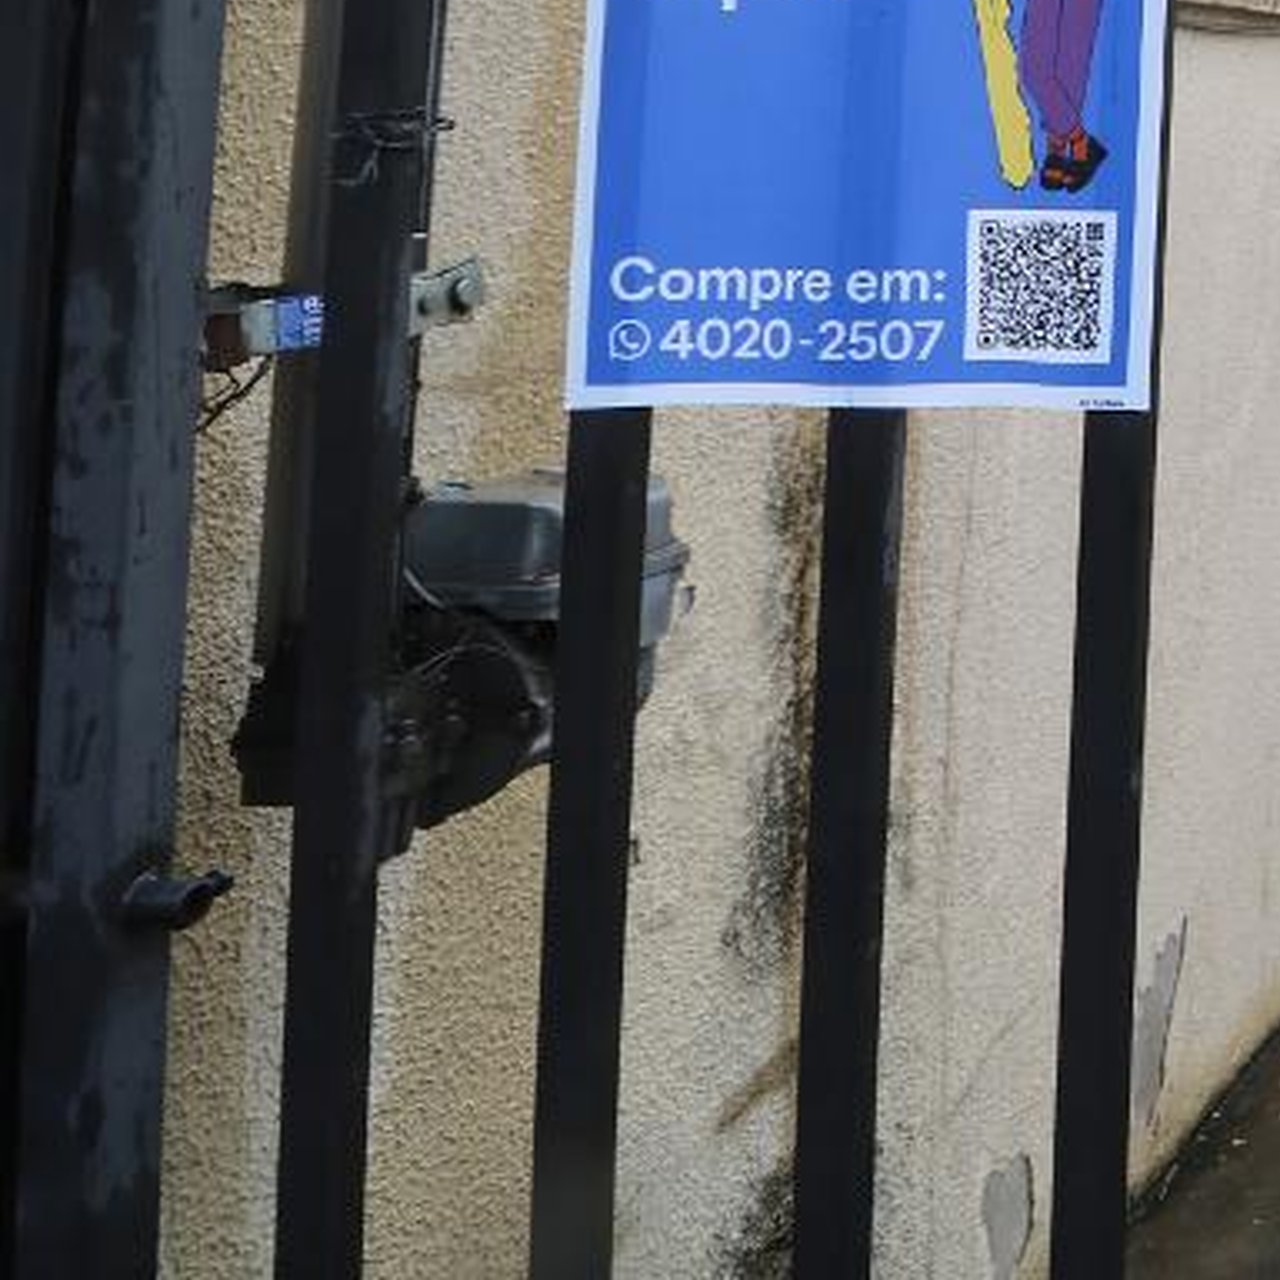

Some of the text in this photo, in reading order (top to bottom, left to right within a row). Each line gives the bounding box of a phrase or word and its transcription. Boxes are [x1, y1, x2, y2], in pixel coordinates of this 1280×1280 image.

[610, 256, 946, 310] Compre em:
[659, 318, 945, 362] 4020-2507
